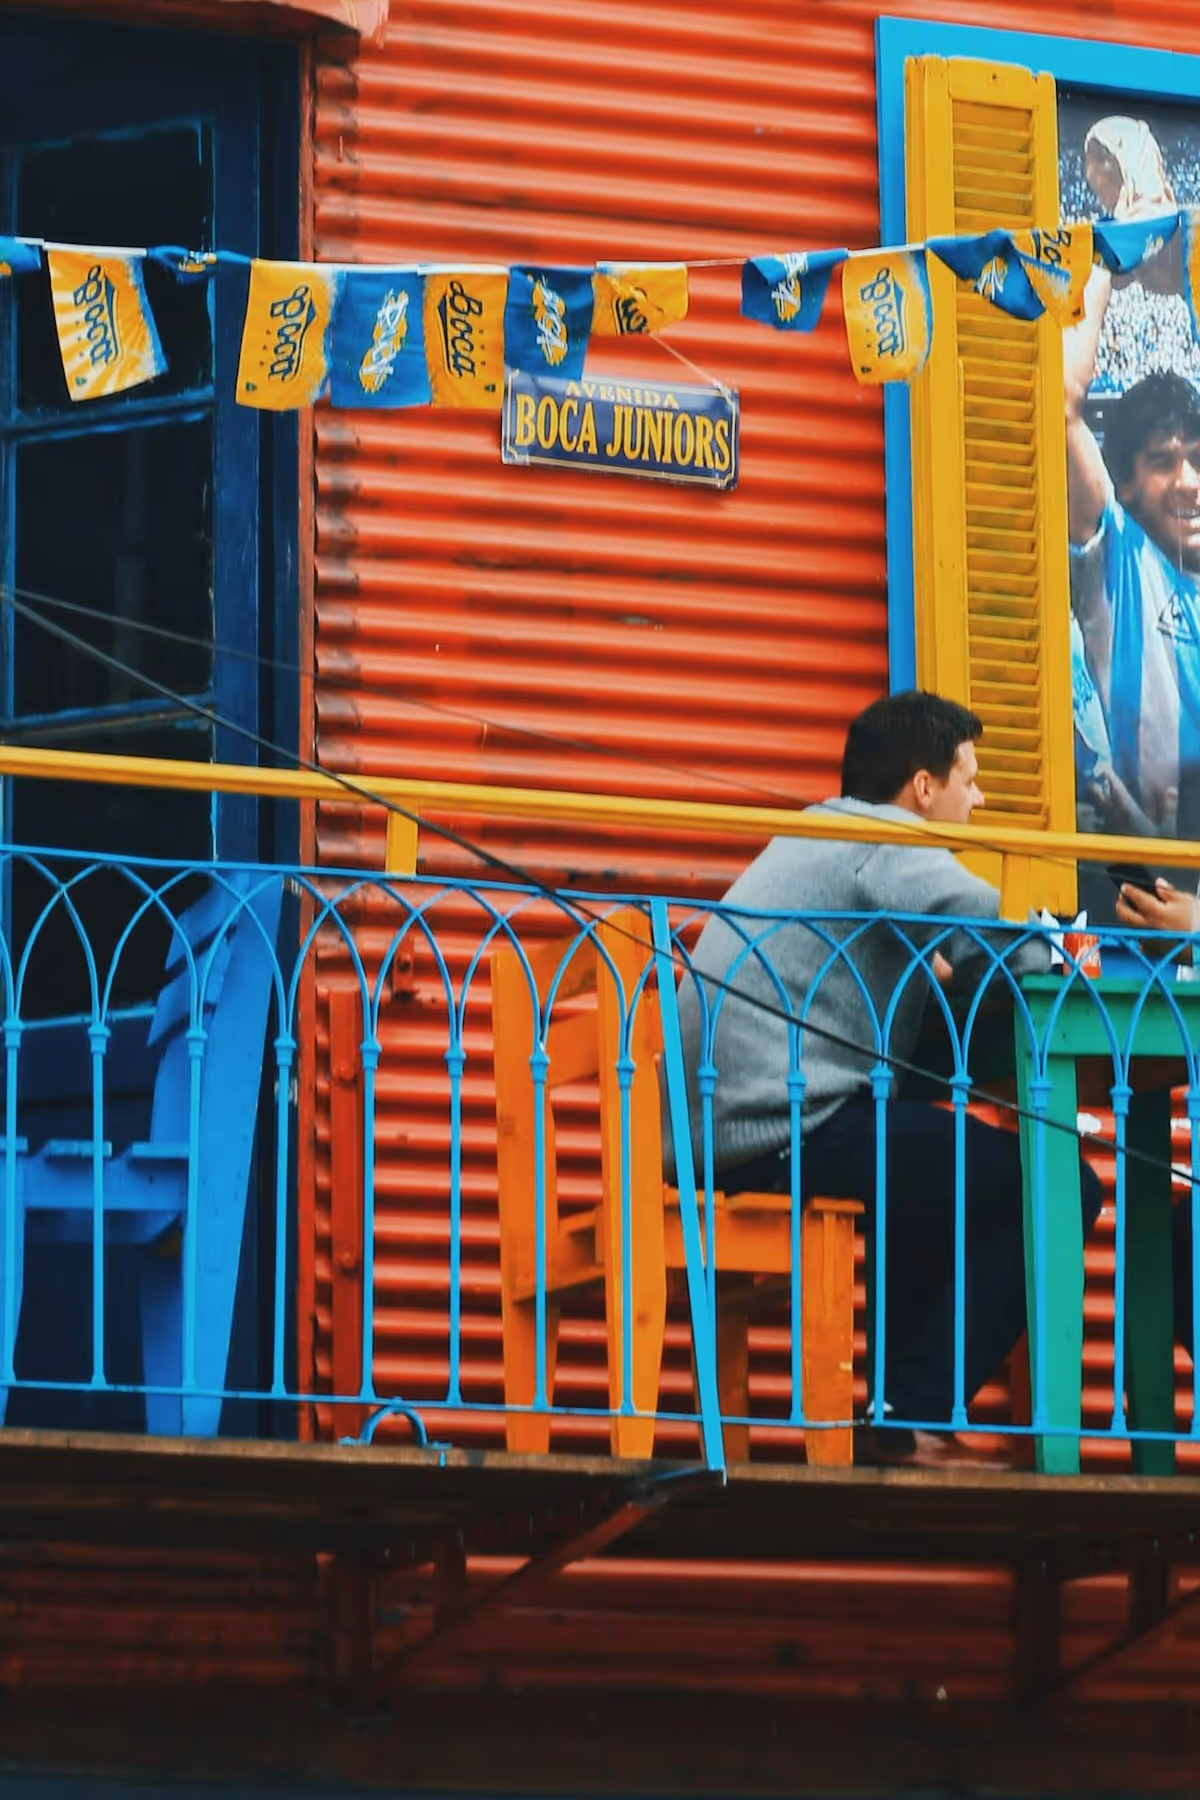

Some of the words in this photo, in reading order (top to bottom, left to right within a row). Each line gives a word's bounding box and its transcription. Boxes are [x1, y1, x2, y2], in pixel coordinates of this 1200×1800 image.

[73, 264, 113, 365] Boca
[268, 285, 309, 382] Boca
[450, 280, 484, 378] Boca
[860, 267, 900, 358] Boca
[515, 394, 598, 455] BOCA
[606, 404, 730, 471] JUNIORS
[566, 380, 680, 410] AVENIDA
